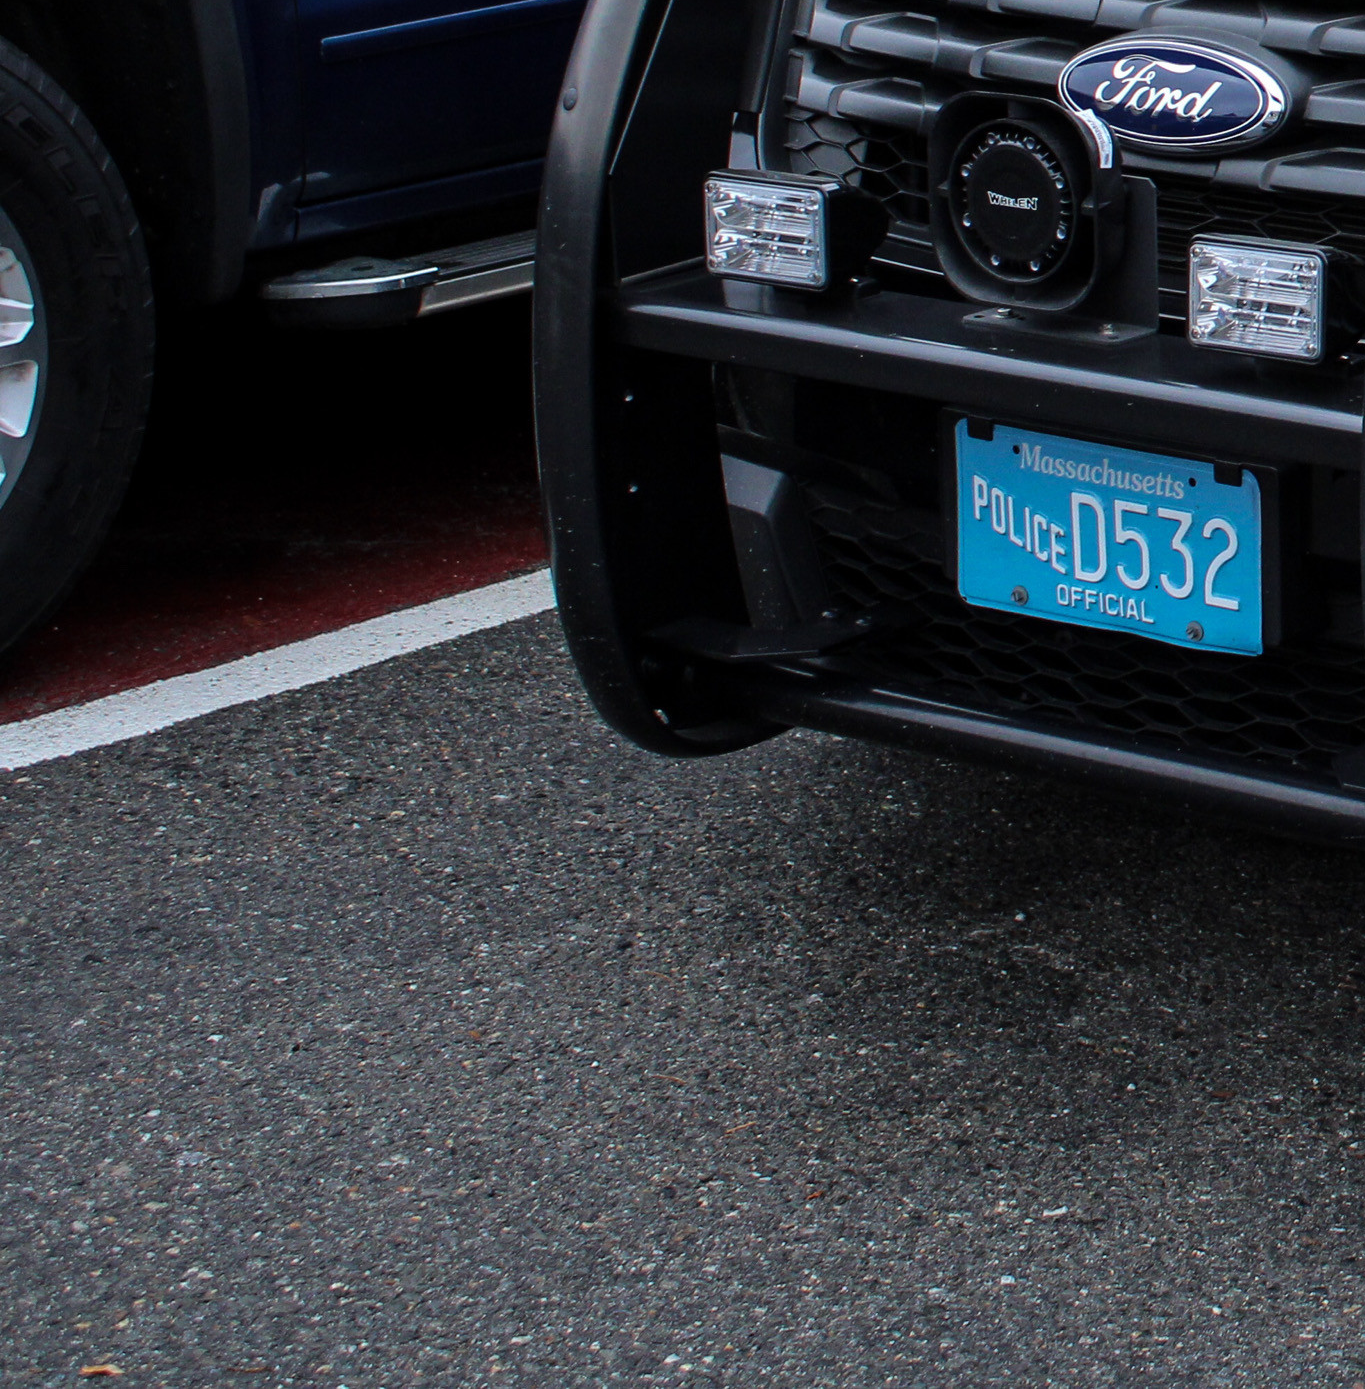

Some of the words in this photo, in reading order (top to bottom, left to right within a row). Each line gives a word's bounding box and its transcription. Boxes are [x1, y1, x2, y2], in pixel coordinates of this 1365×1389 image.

[1094, 54, 1224, 122] Ford
[986, 190, 1039, 211] WHELEN
[1018, 442, 1187, 500] Massachusetts
[972, 474, 1068, 576] POLICE
[1070, 491, 1241, 612] D532
[1055, 582, 1156, 624] OFFICIAL
